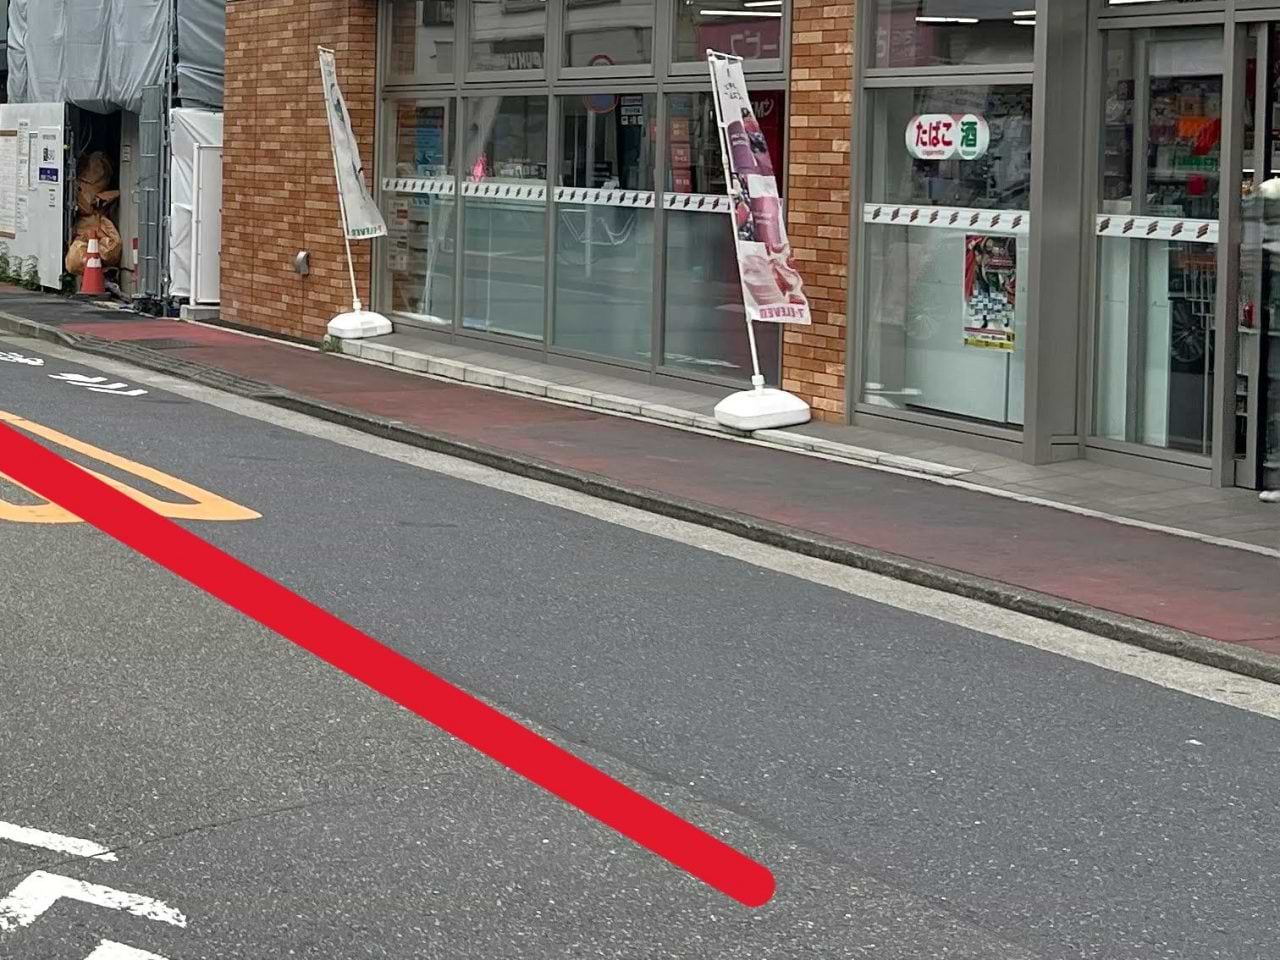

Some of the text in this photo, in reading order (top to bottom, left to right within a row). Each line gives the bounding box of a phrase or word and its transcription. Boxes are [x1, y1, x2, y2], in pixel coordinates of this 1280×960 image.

[916, 121, 953, 148] たばこ
[960, 121, 978, 148] 酒
